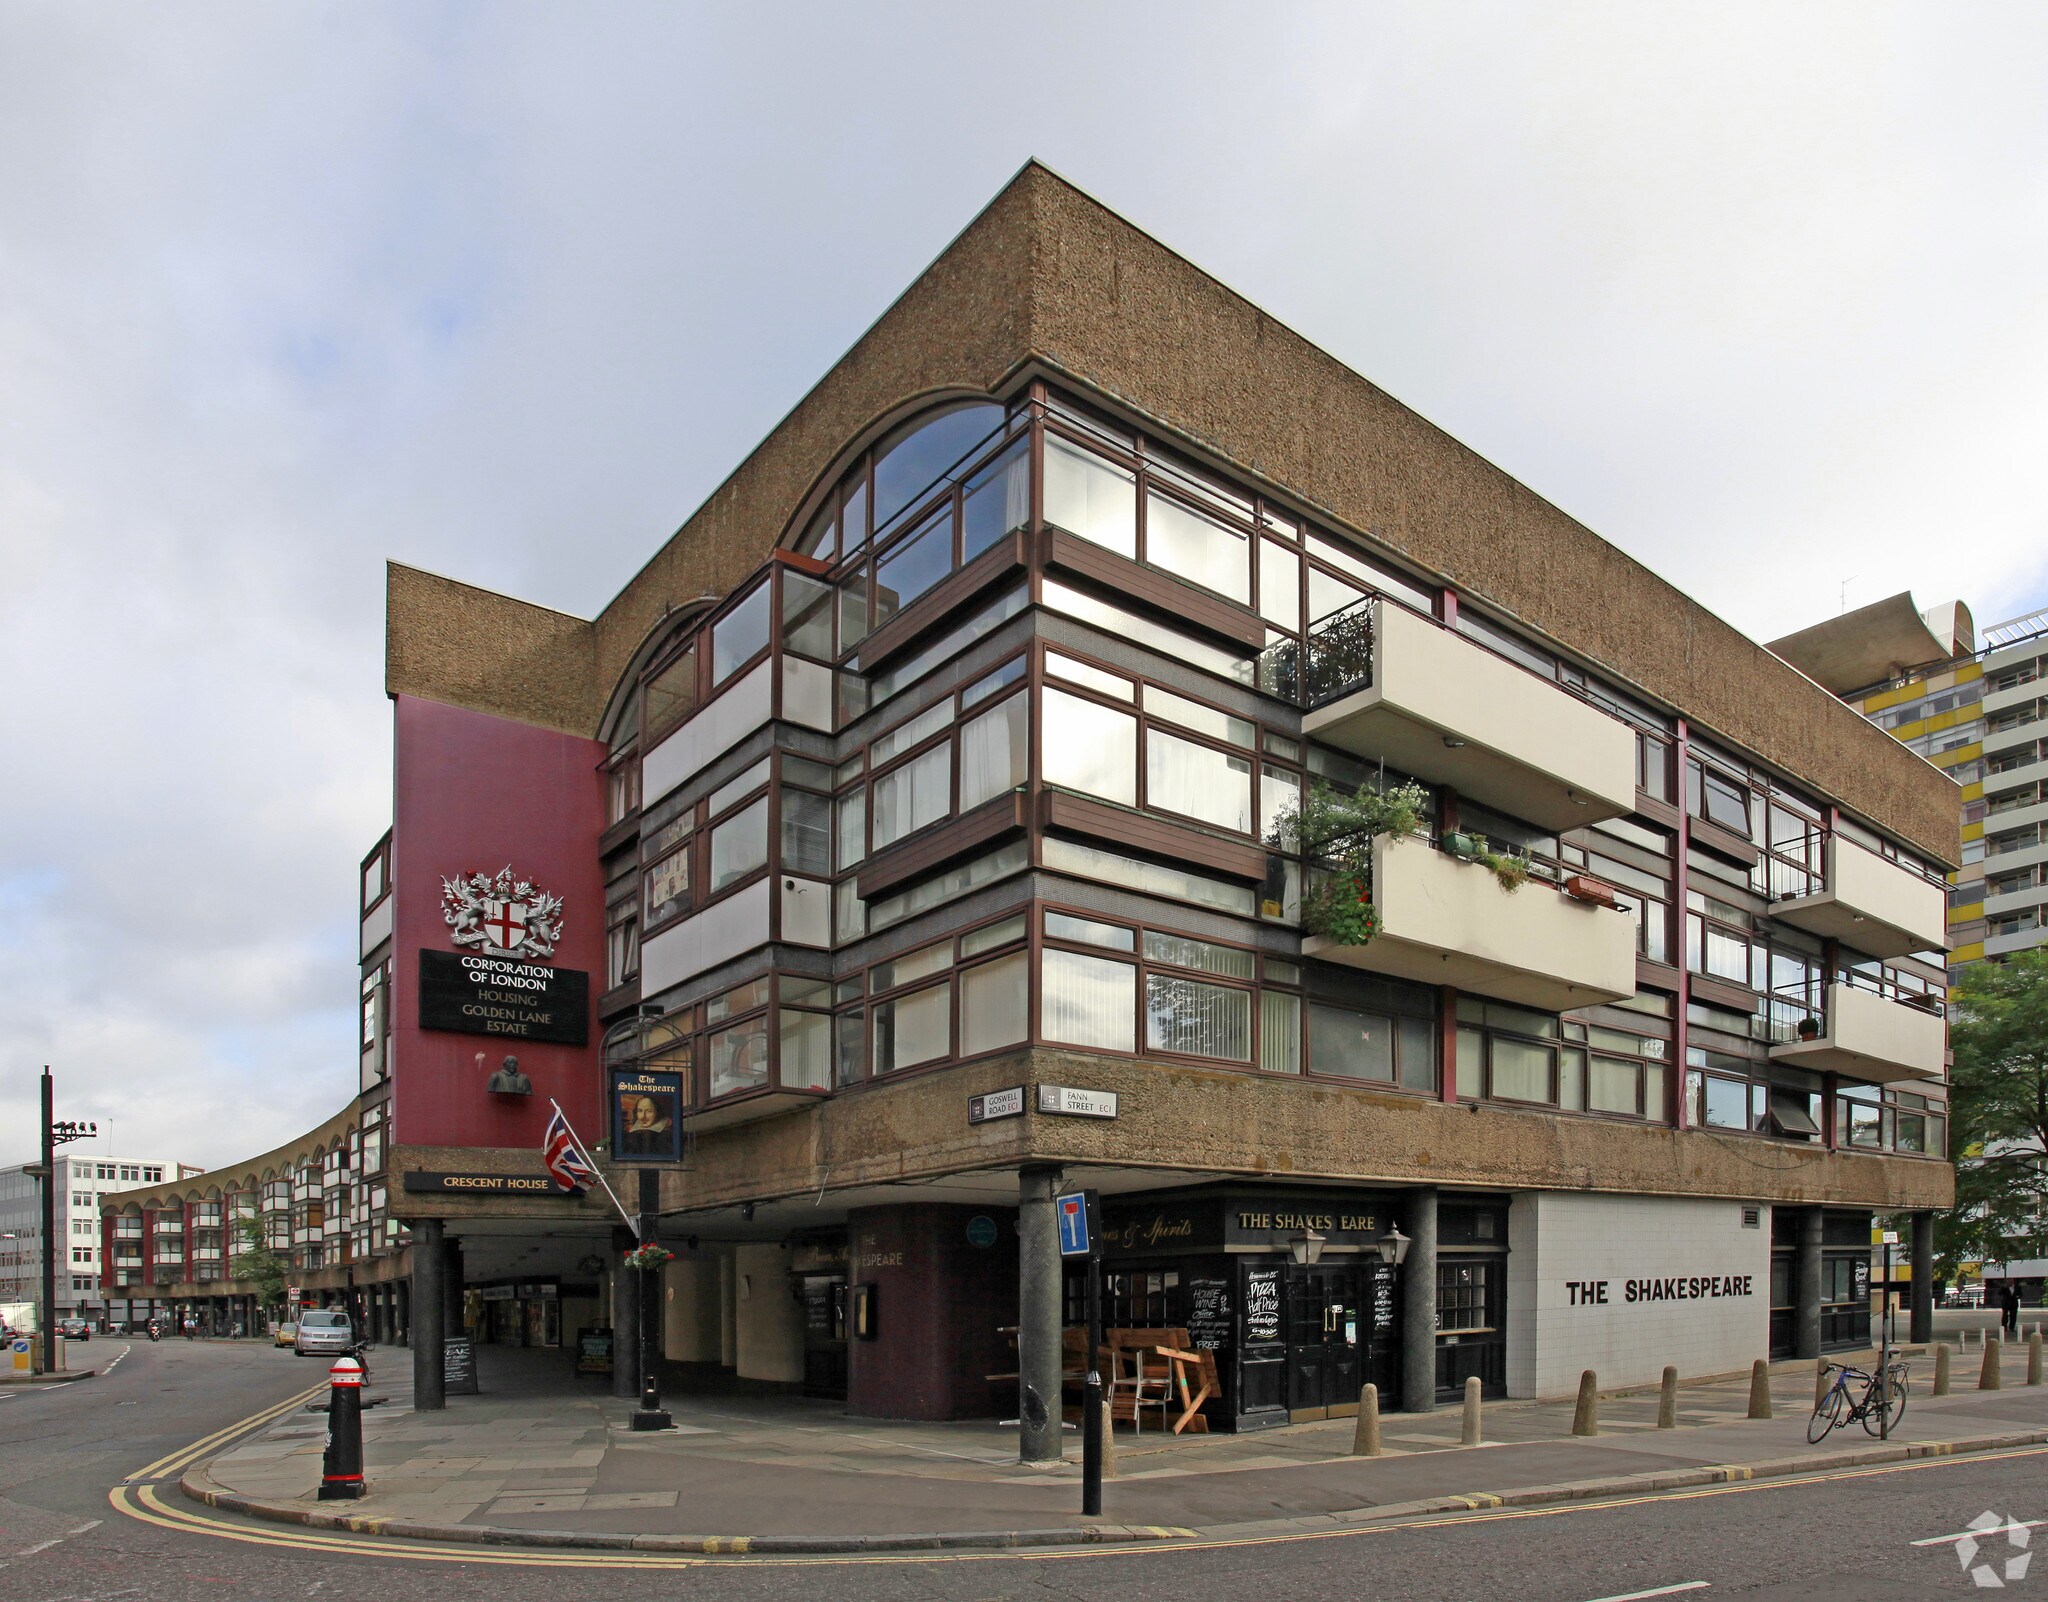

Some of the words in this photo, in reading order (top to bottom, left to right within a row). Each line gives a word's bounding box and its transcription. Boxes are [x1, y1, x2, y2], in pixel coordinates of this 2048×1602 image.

[461, 956, 554, 979] CORPORATION
[469, 971, 488, 983] OF
[491, 974, 546, 991] LONDON
[478, 989, 538, 1007] HOUSING
[462, 1004, 516, 1020] GOLDEN
[519, 1011, 551, 1025] LANE
[487, 1021, 528, 1035] ESTATE
[638, 1074, 656, 1084] The
[617, 1081, 676, 1093] Shakespeare
[988, 1091, 1018, 1106] GOSWELL
[1067, 1091, 1088, 1101] FANN
[988, 1103, 1007, 1115] ROAD
[1067, 1102, 1094, 1111] STREET
[443, 1176, 503, 1188] CRESCENT
[507, 1179, 548, 1190] HOUSE
[1240, 1212, 1271, 1228] THE
[1123, 1220, 1141, 1248] &
[1143, 1214, 1192, 1245] Spirits
[860, 1252, 903, 1267] ESPEARE
[1250, 1281, 1277, 1299] PIZZA
[1565, 1281, 1609, 1306] THE
[1625, 1275, 1752, 1303] SHAKESPEARE
[1195, 1298, 1218, 1309] WINE
[1248, 1297, 1262, 1315] Half
[1261, 1296, 1279, 1311] Price
[445, 1348, 470, 1356] EAK
[1196, 1340, 1220, 1349] FREE
